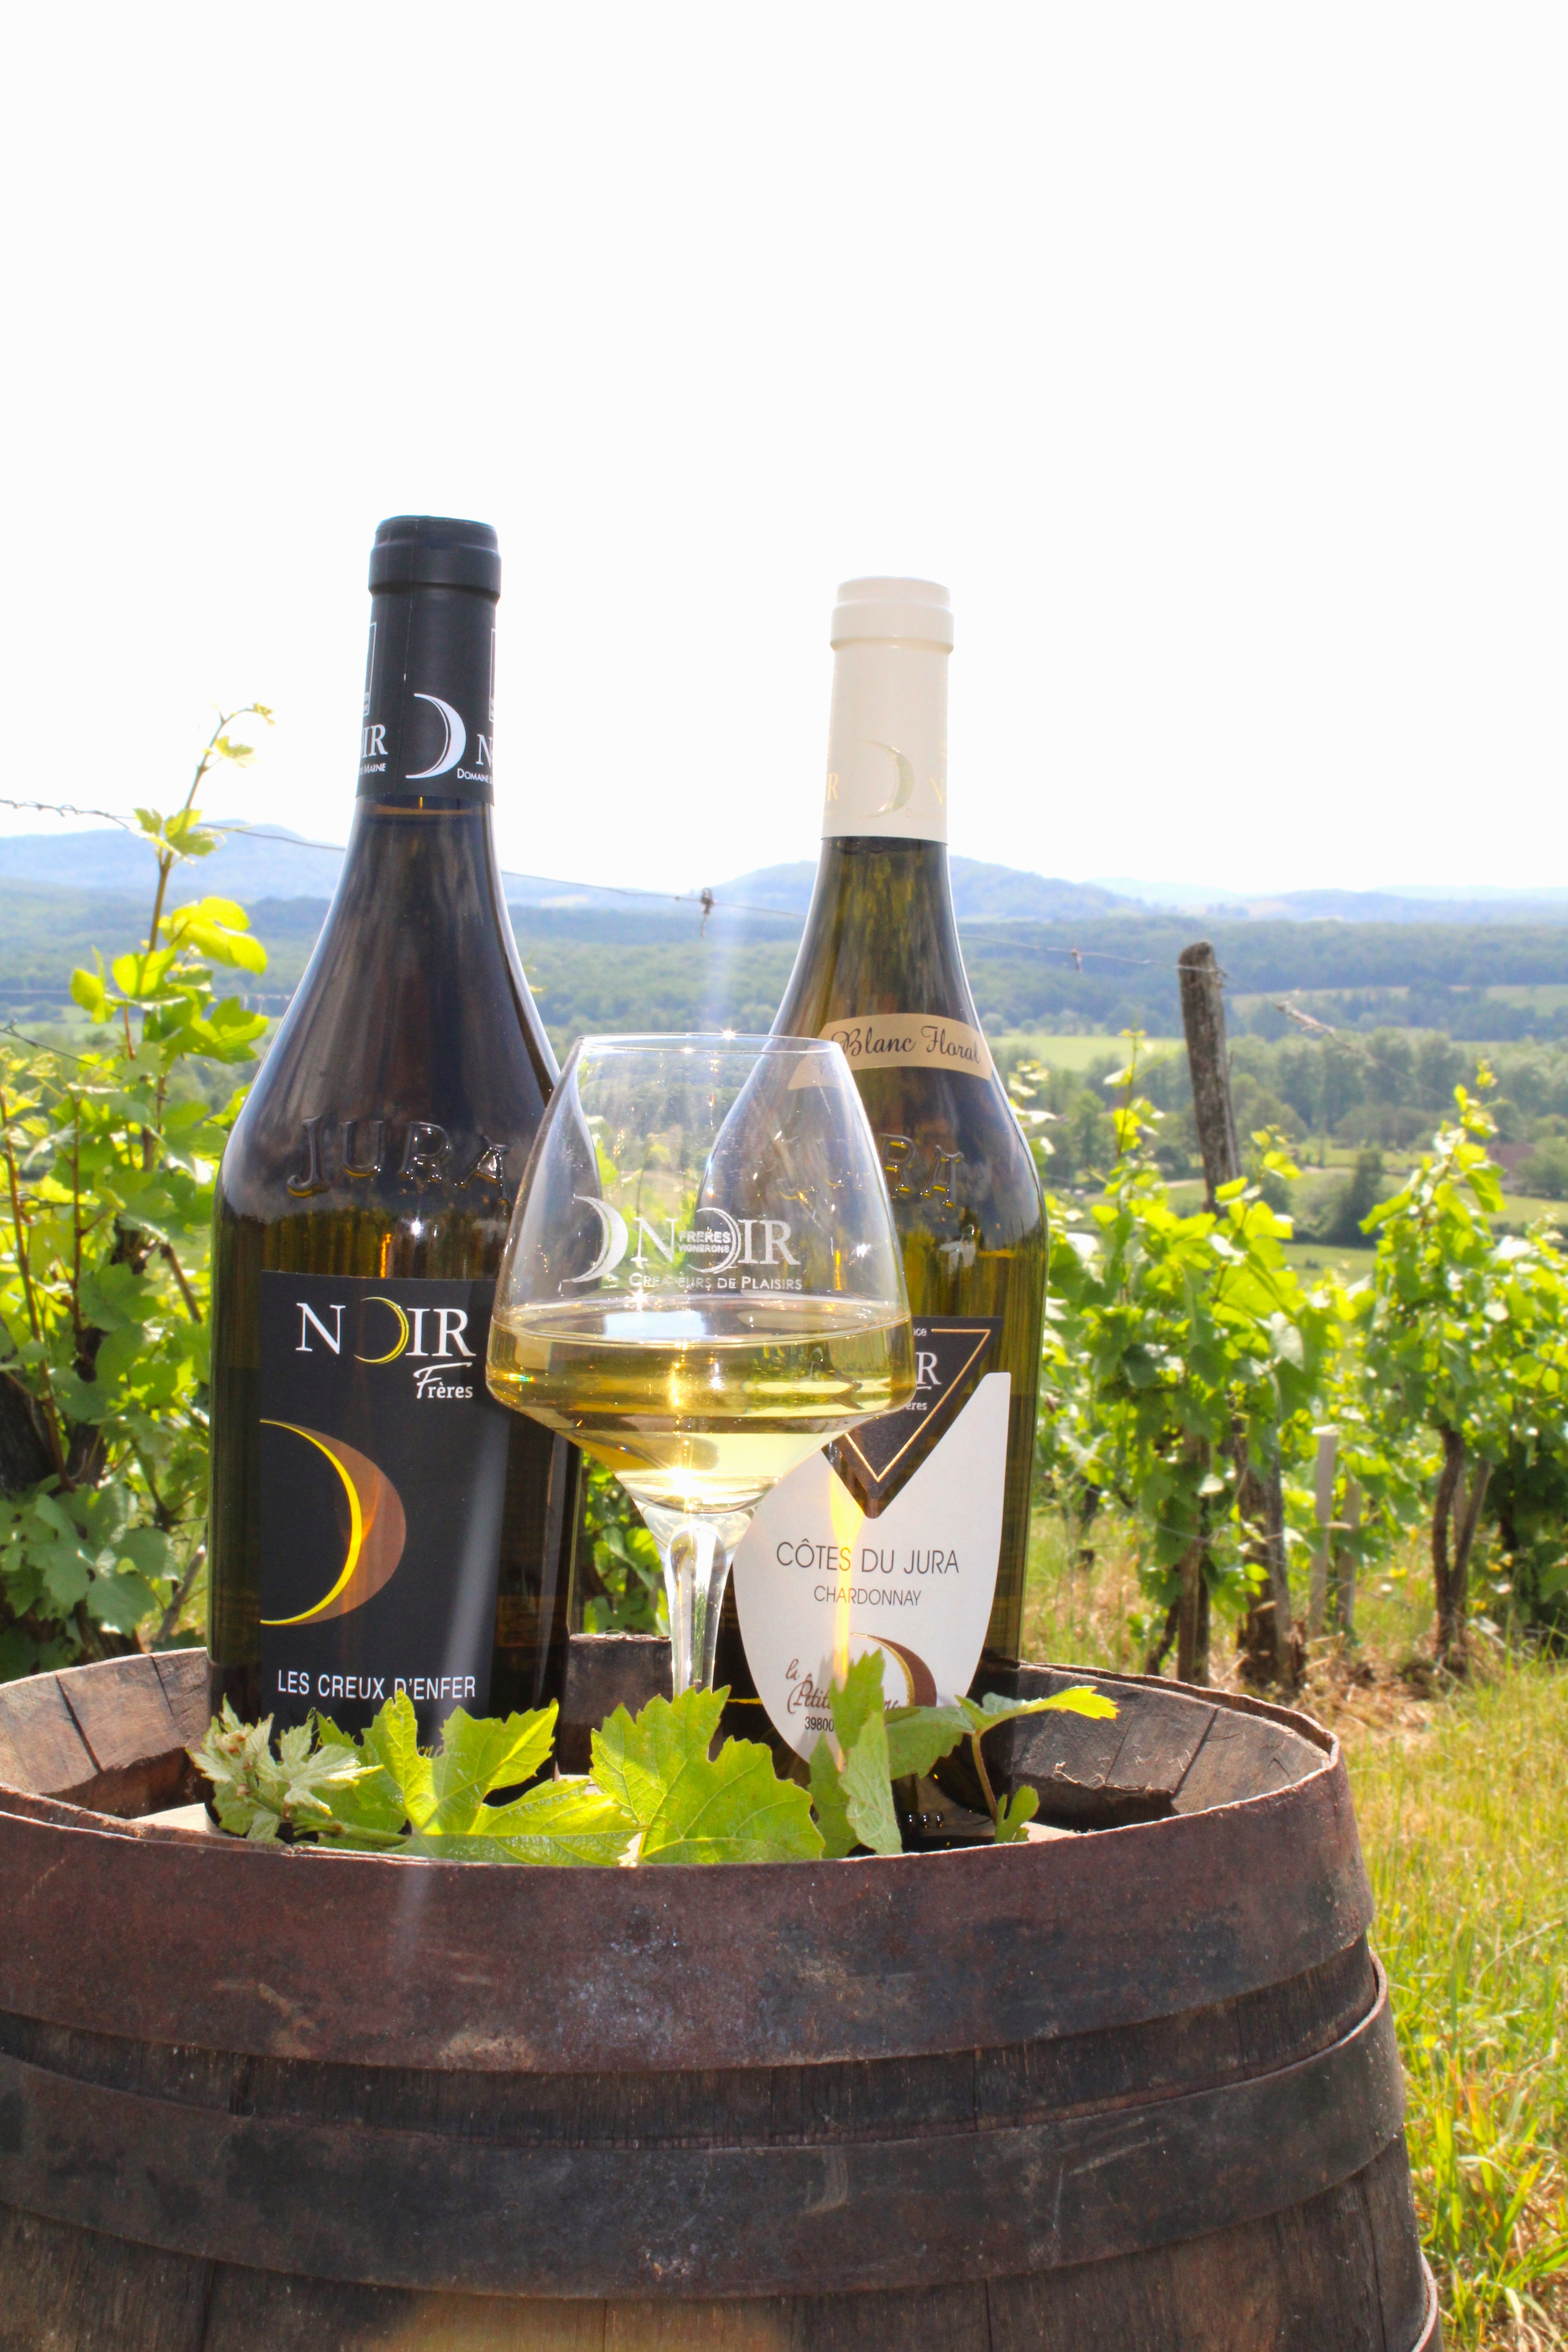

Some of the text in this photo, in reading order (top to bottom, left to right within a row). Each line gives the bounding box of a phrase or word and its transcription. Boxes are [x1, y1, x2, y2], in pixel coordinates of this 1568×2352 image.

[362, 724, 388, 759] IR
[832, 1025, 980, 1064] Blanc Floral
[287, 1116, 510, 1206] JURA
[629, 1272, 803, 1290] CREAEURS DE PLAISIRS
[413, 1362, 473, 1399] Frères
[777, 1539, 959, 1574] CÔTES DU JURA
[814, 1585, 922, 1606] CHARDONNAY
[278, 1670, 476, 1700] LES CREUX D'ENFER
[786, 1659, 799, 1680] la
[787, 1673, 831, 1714] Petit
[804, 1716, 834, 1732] 39800
